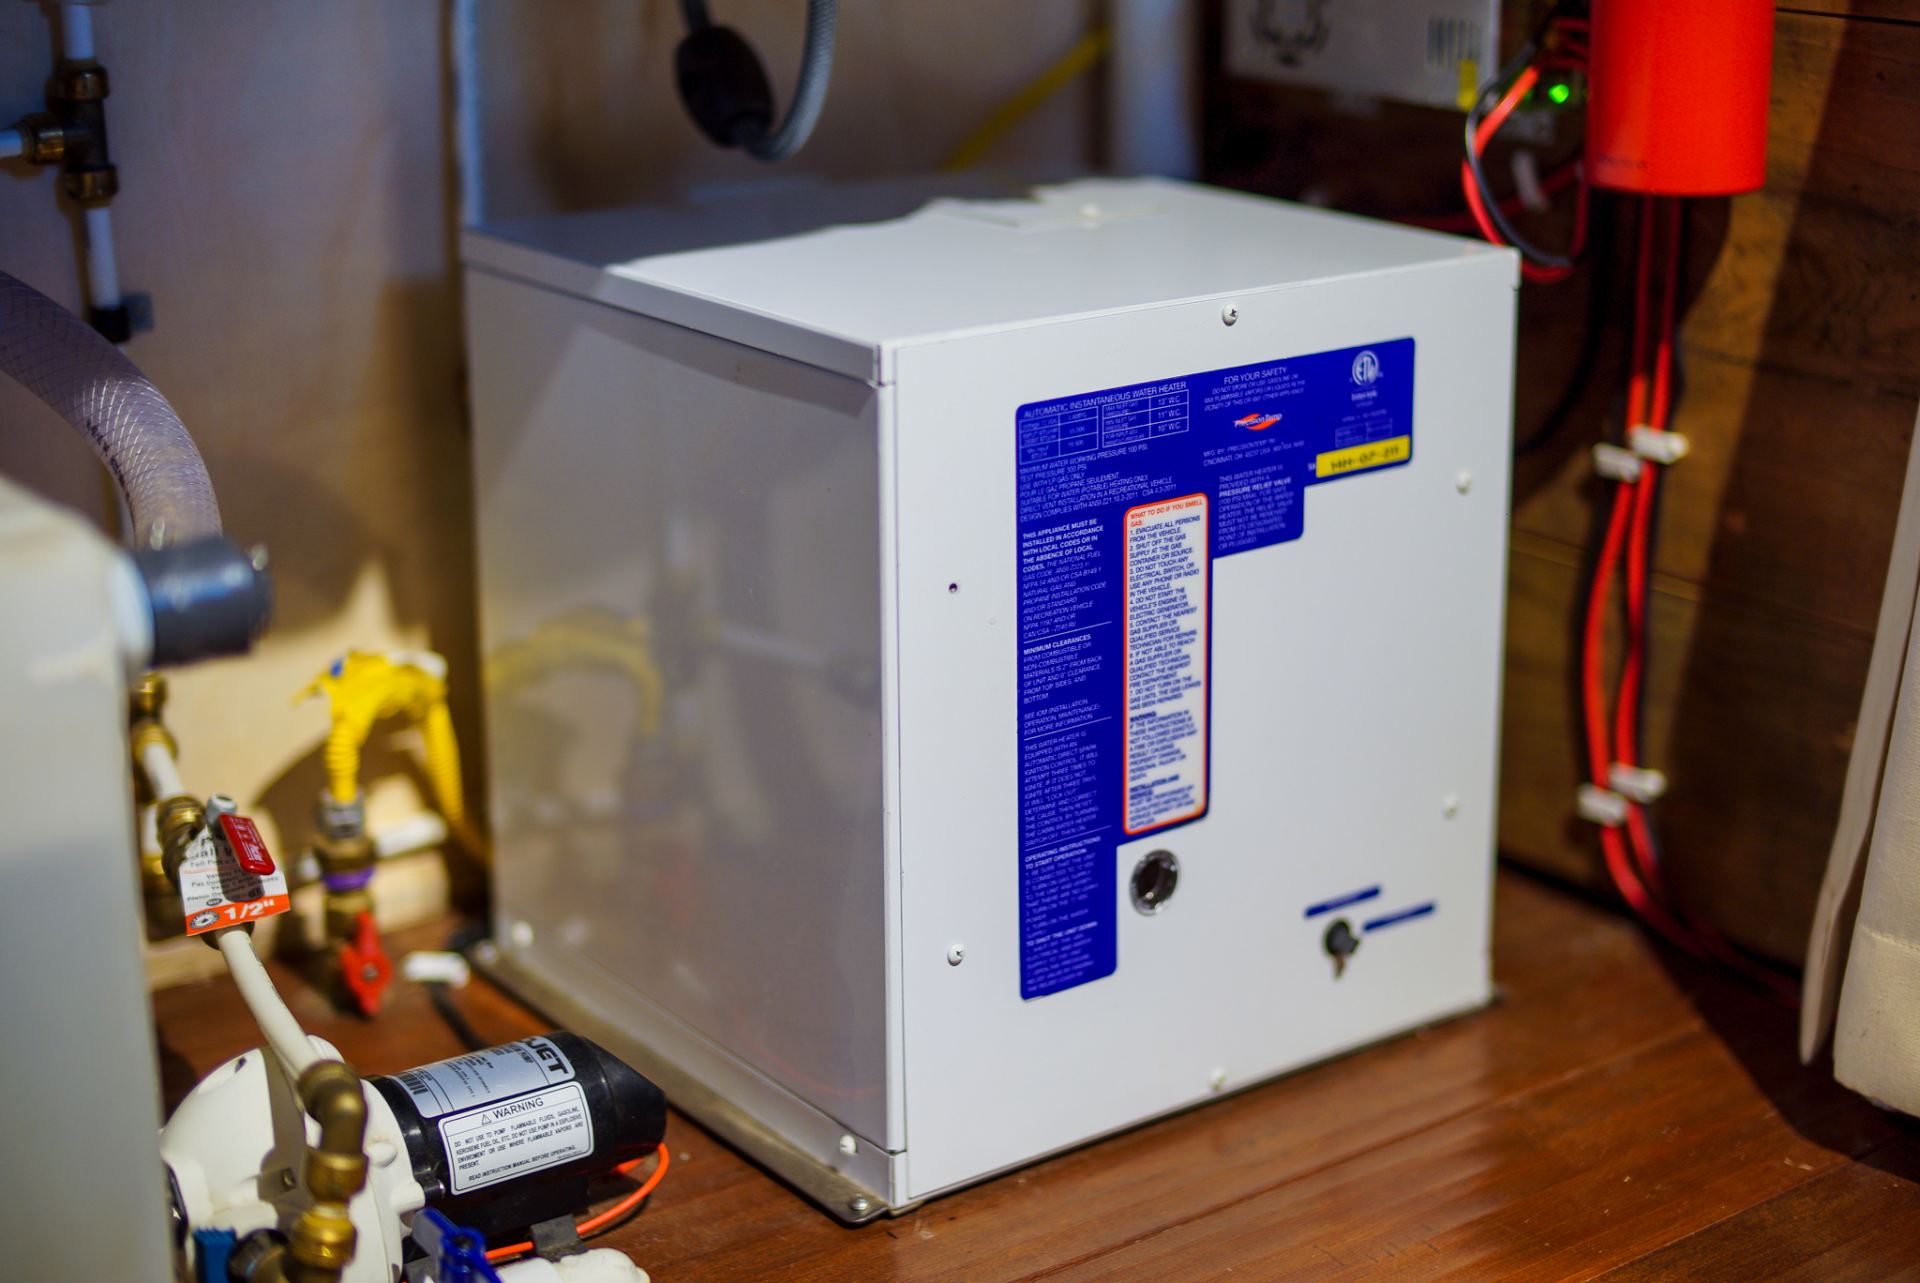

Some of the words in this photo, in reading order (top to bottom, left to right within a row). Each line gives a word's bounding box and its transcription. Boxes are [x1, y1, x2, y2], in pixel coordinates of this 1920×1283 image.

[1223, 375, 1238, 384] FOR
[1240, 371, 1260, 381] YOUR
[1261, 366, 1287, 377] SAFETY
[1023, 403, 1068, 417] AUTOMATIC
[1070, 392, 1130, 408] INSTANTANEOUS
[1131, 387, 1157, 397] WATER
[1158, 381, 1186, 392] HEATER
[1049, 459, 1068, 468] WATER
[1069, 454, 1096, 464] WORKING
[1097, 447, 1126, 458] PRESSURE
[1128, 445, 1137, 453] 100
[1020, 473, 1033, 482] TEST
[1034, 468, 1065, 479] PRESSURE
[1219, 485, 1250, 497] PRESSURE
[1252, 481, 1272, 490] RELIEF
[1273, 476, 1291, 485] VALVE
[1022, 531, 1036, 539] THIS
[1037, 524, 1070, 535] APPLIANCE
[1135, 523, 1162, 533] EVACUATE
[1164, 520, 1173, 528] ALL
[1175, 515, 1200, 524] PERSONS
[1022, 536, 1054, 547] INSTALLED
[1063, 525, 1103, 538] ACCORDANCE
[1151, 538, 1162, 546] OFF
[1022, 548, 1037, 556] WITH
[1039, 543, 1058, 552] LOCAL
[1059, 539, 1080, 547] CODES
[1023, 556, 1034, 564] THE
[1036, 551, 1063, 561] ABSENCE
[1074, 544, 1093, 552] LOCAL
[1129, 550, 1149, 558] SUPPLY
[1129, 555, 1160, 566] CONTAINER
[1144, 563, 1155, 571] NOT
[1157, 559, 1176, 567] TOUCH
[1129, 570, 1161, 582] ELECTRICAL
[1129, 582, 1140, 590] USE
[1154, 575, 1172, 583] PHONE
[1182, 568, 1199, 576] RADIO
[1145, 593, 1155, 601] NOT
[1024, 644, 1051, 654] MINIMUM
[1052, 634, 1091, 647] CLEARANCES
[224, 898, 275, 921] 1/2"
[521, 1037, 569, 1075] JET
[493, 1097, 544, 1119] WARNING
[493, 1127, 505, 1135] PUMP
[510, 1119, 536, 1130] FLAMMABLE
[508, 1139, 524, 1147] WHERE
[527, 1131, 553, 1142] FLAMMABLE
[555, 1125, 572, 1133] VAPORS
[456, 1144, 480, 1155] KEROSENE
[480, 1140, 492, 1148] FUEL
[528, 1126, 537, 1134] USE
[537, 1123, 549, 1131] PUMP
[468, 1173, 481, 1181] READ
[481, 1164, 512, 1176] INSTRUCTION
[512, 1159, 530, 1167] MANUAL
[531, 1153, 549, 1162] BEFORE
